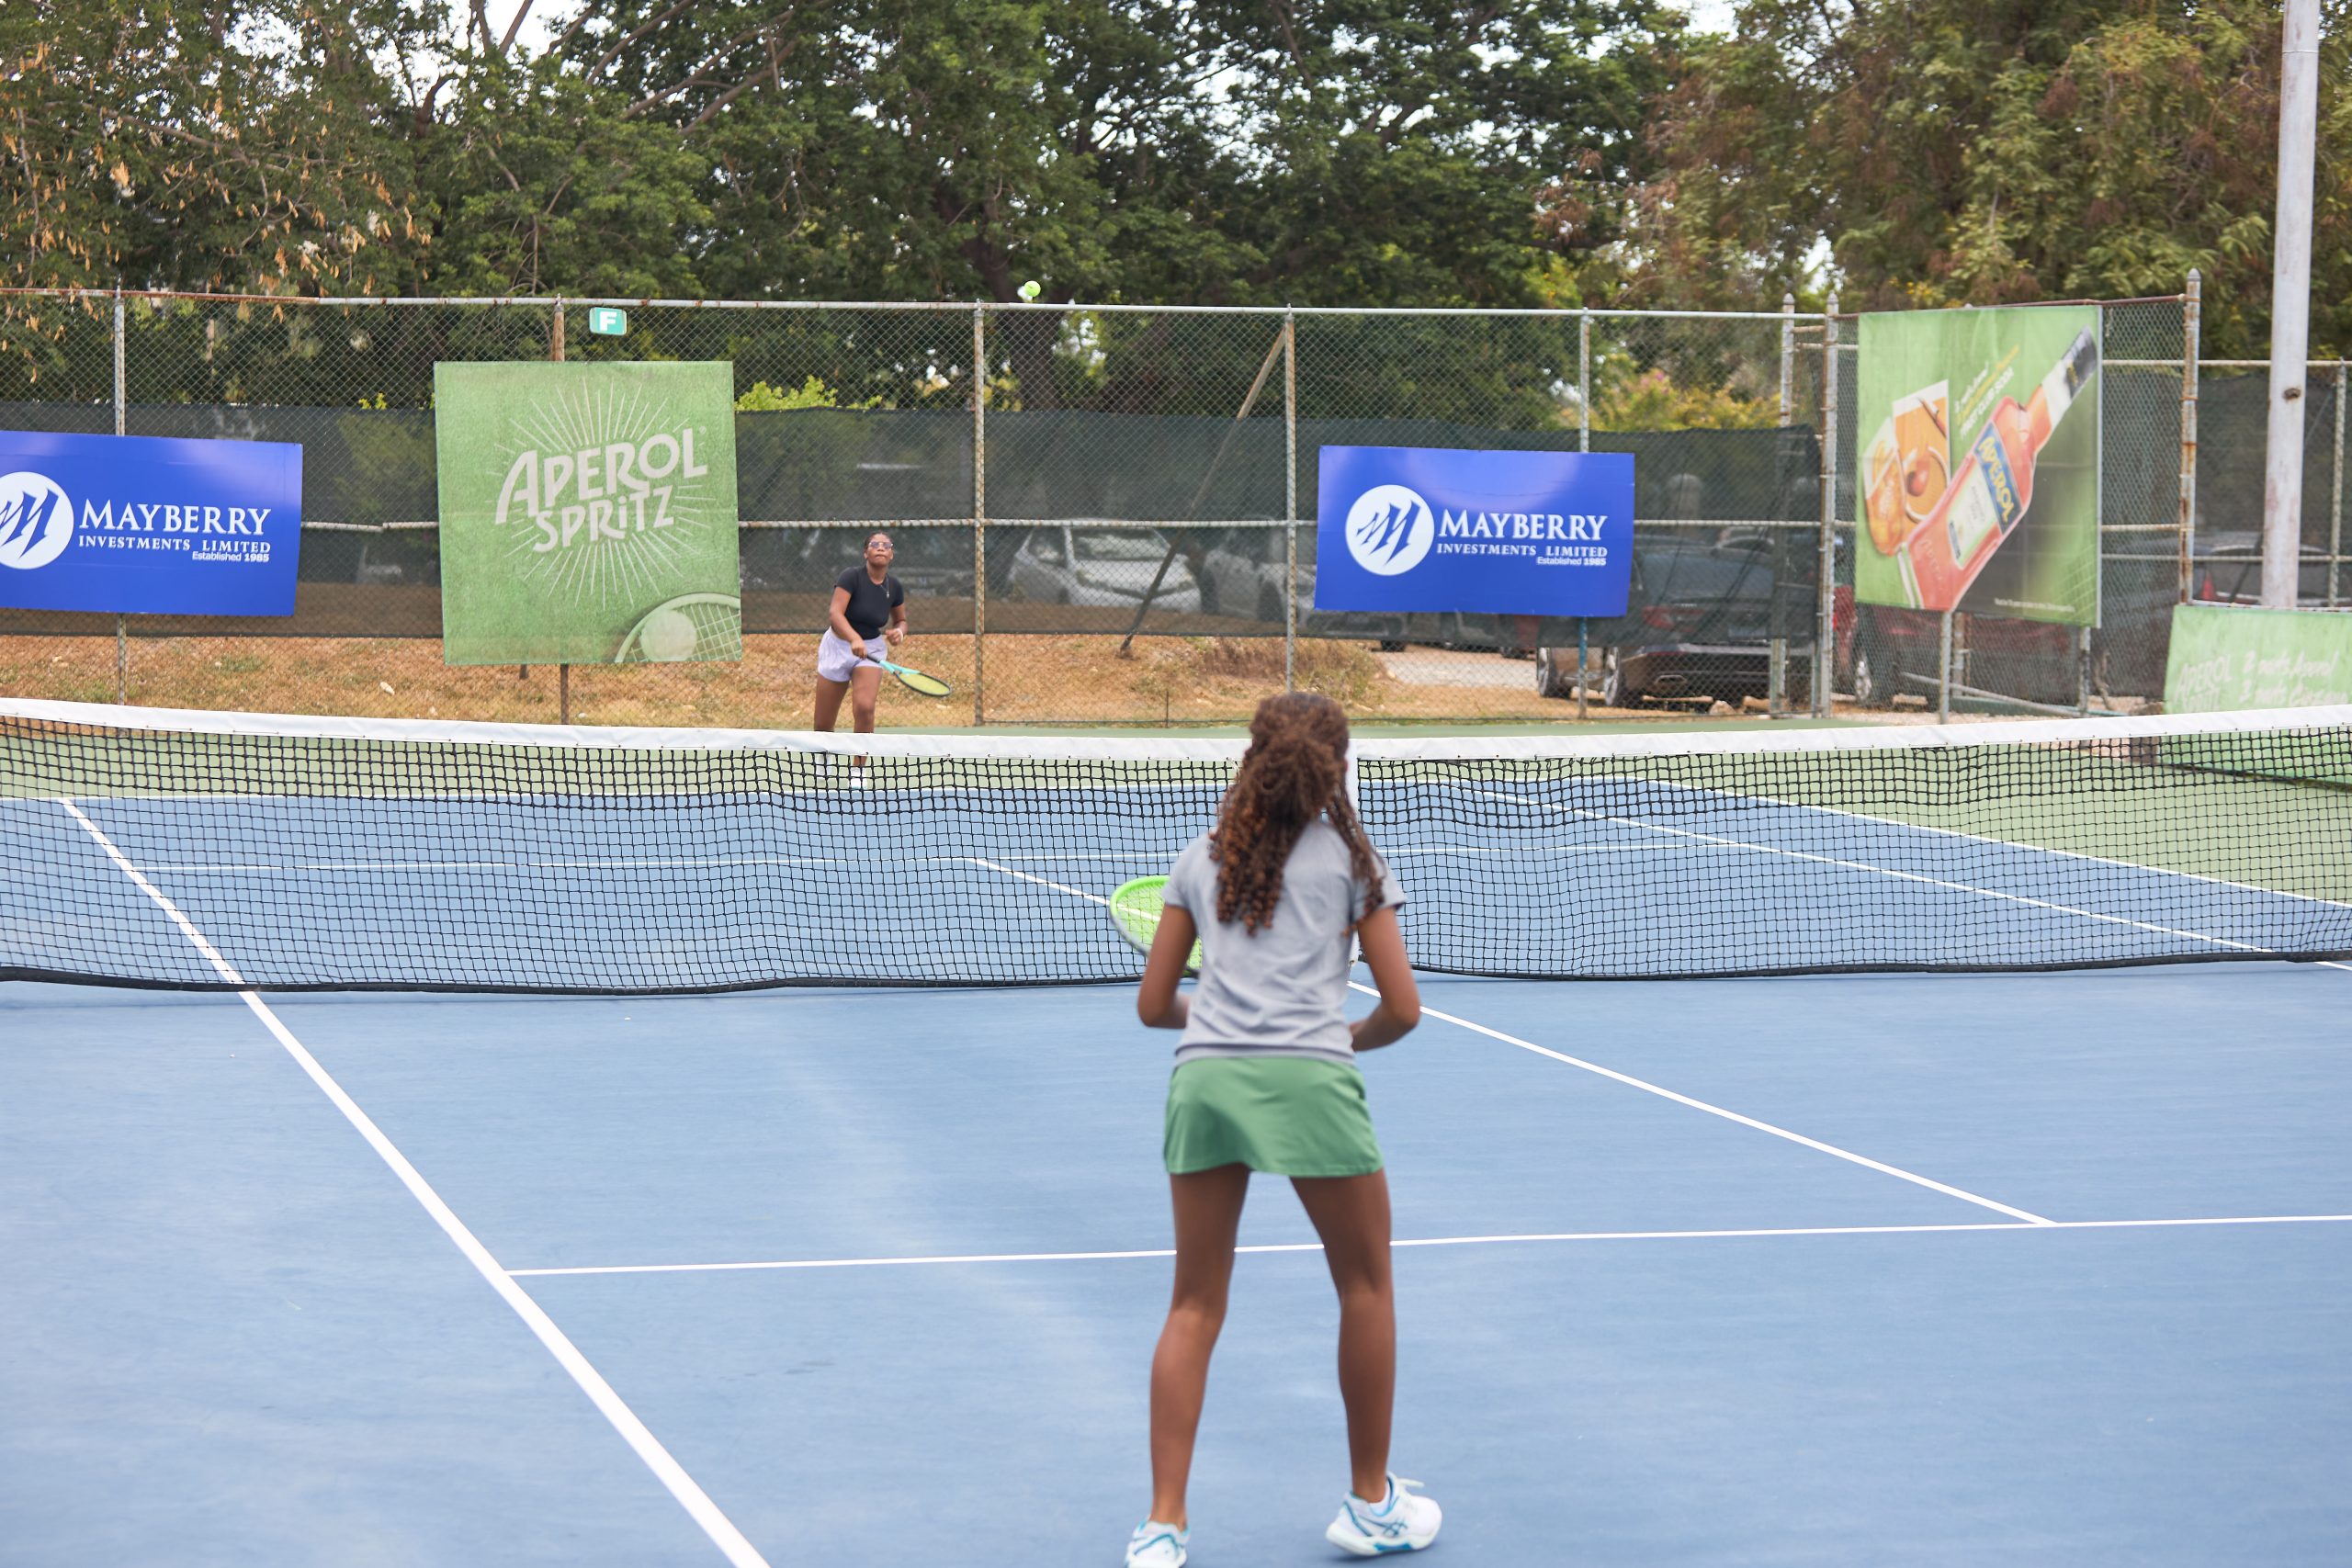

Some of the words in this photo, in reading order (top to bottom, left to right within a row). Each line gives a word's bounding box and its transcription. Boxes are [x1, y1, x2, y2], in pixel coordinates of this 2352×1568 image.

[599, 310, 616, 331] F
[494, 427, 708, 525] APEROL
[1977, 435, 2015, 524] APEROL
[79, 499, 271, 536] MAYBERRY
[1439, 509, 1608, 540] MAYBERRY
[79, 536, 191, 551] INVESTMENTS
[202, 539, 271, 553] LIMITED
[1437, 543, 1536, 556] INVESTMENTS
[1545, 546, 1608, 558] LIMITED
[192, 551, 242, 562] Established
[244, 553, 270, 562] 1985
[1536, 557, 1581, 566] Established
